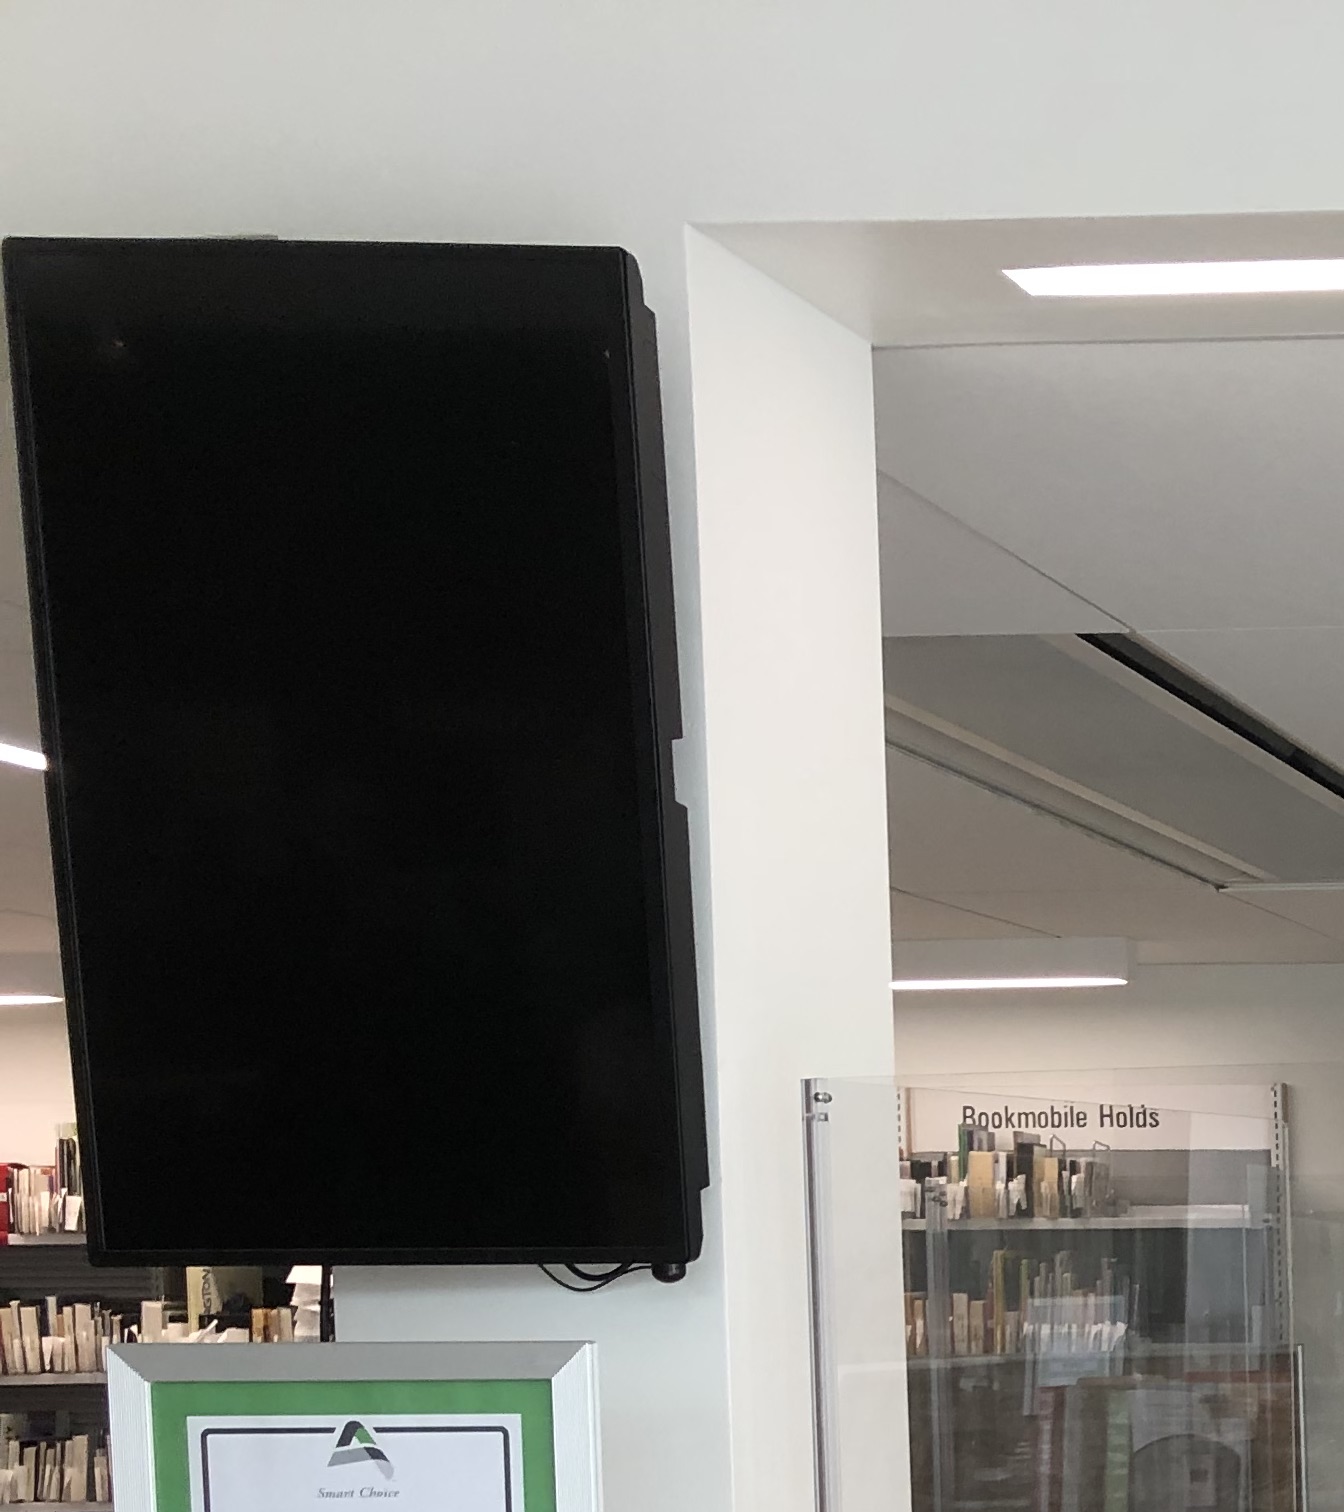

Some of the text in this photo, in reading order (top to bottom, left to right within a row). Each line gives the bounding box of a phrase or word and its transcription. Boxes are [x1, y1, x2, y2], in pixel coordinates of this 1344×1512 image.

[961, 1104, 1161, 1130] Bookmobile Holds
[316, 1486, 399, 1499] Smart Choice
